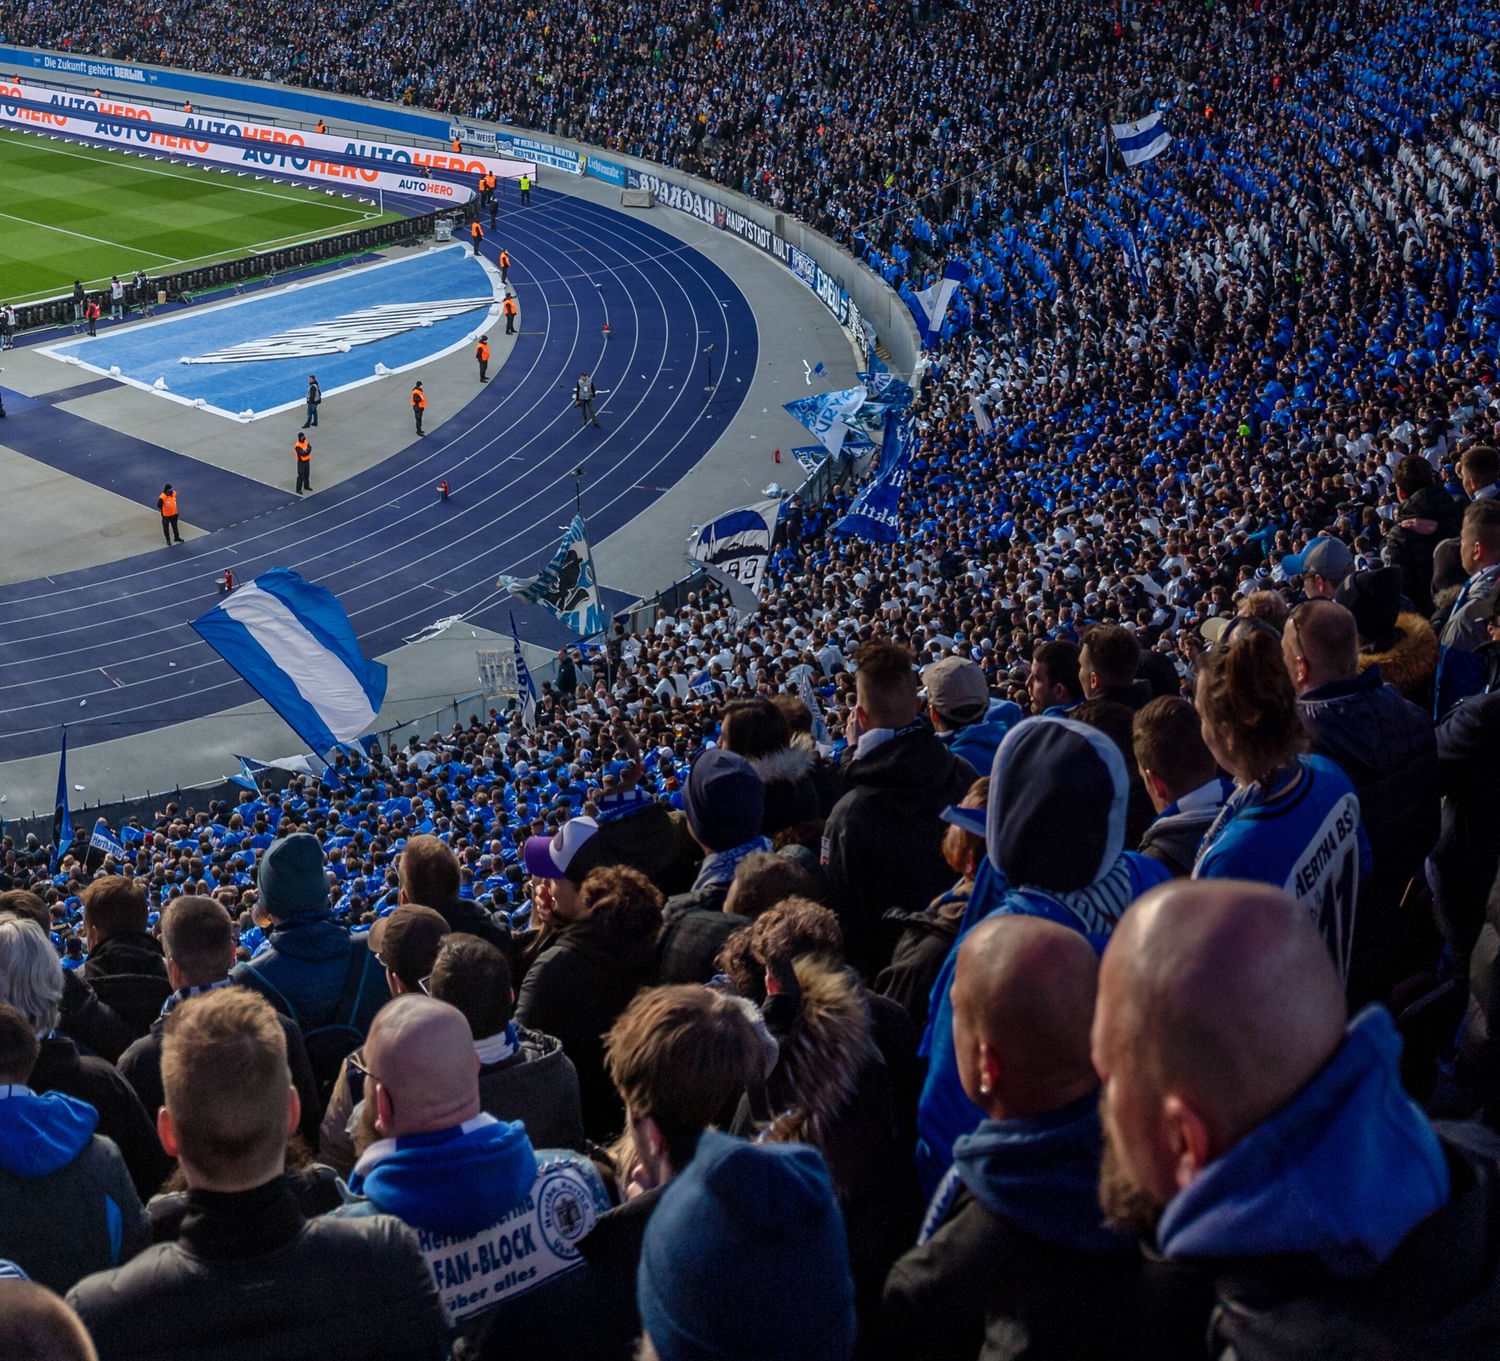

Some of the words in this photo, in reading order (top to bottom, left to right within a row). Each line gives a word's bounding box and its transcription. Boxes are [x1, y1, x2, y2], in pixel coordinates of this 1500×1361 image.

[44, 56, 57, 69] Die
[57, 58, 87, 74] Zukunft
[87, 62, 113, 78] gehört
[451, 128, 467, 141] BLAU
[475, 130, 496, 144] WEISS
[398, 178, 455, 197] AUTOHERO
[726, 208, 772, 251] HAUPTSTADT
[771, 234, 791, 264] KULT
[433, 1223, 537, 1290] FAN-BLOCK
[494, 1267, 537, 1294] alles
